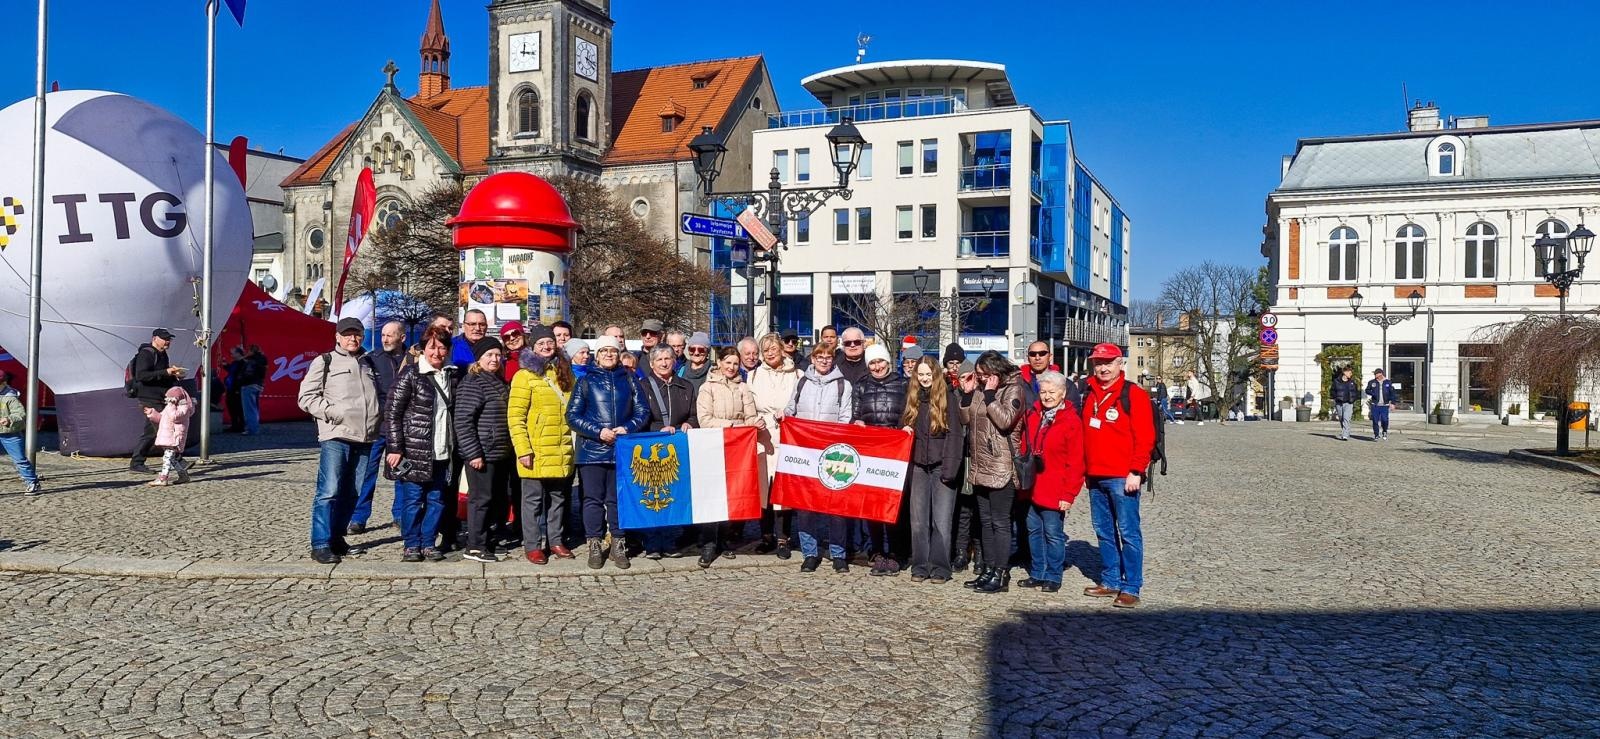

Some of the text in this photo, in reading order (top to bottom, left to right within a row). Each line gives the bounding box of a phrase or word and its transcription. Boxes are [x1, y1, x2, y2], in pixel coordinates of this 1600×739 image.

[52, 192, 187, 244] ITG
[508, 252, 534, 264] KARAOKE
[1263, 316, 1275, 324] 30
[784, 455, 811, 466] ODDZIAŁ
[866, 467, 900, 479] RACIBORZ
